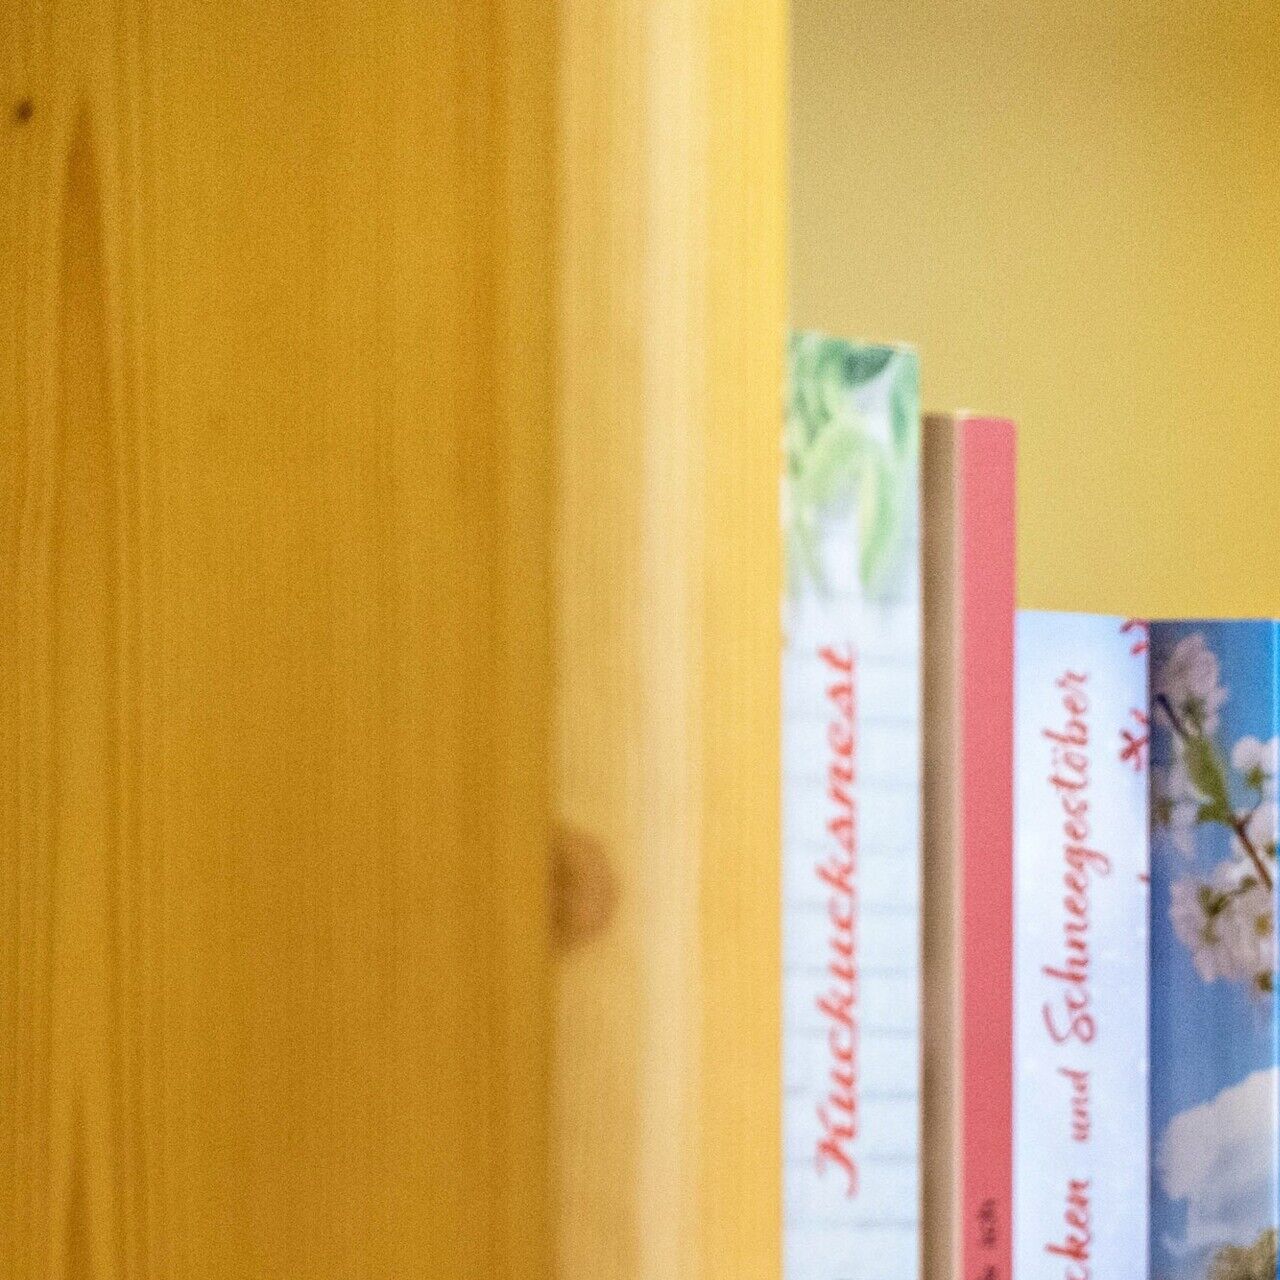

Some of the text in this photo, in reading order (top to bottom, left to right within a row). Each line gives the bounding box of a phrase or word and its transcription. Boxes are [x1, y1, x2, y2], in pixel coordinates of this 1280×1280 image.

[814, 641, 859, 1199] Kuckucksnest
[1041, 667, 1110, 1045] Schneegestöber
[1073, 1064, 1091, 1144] und
